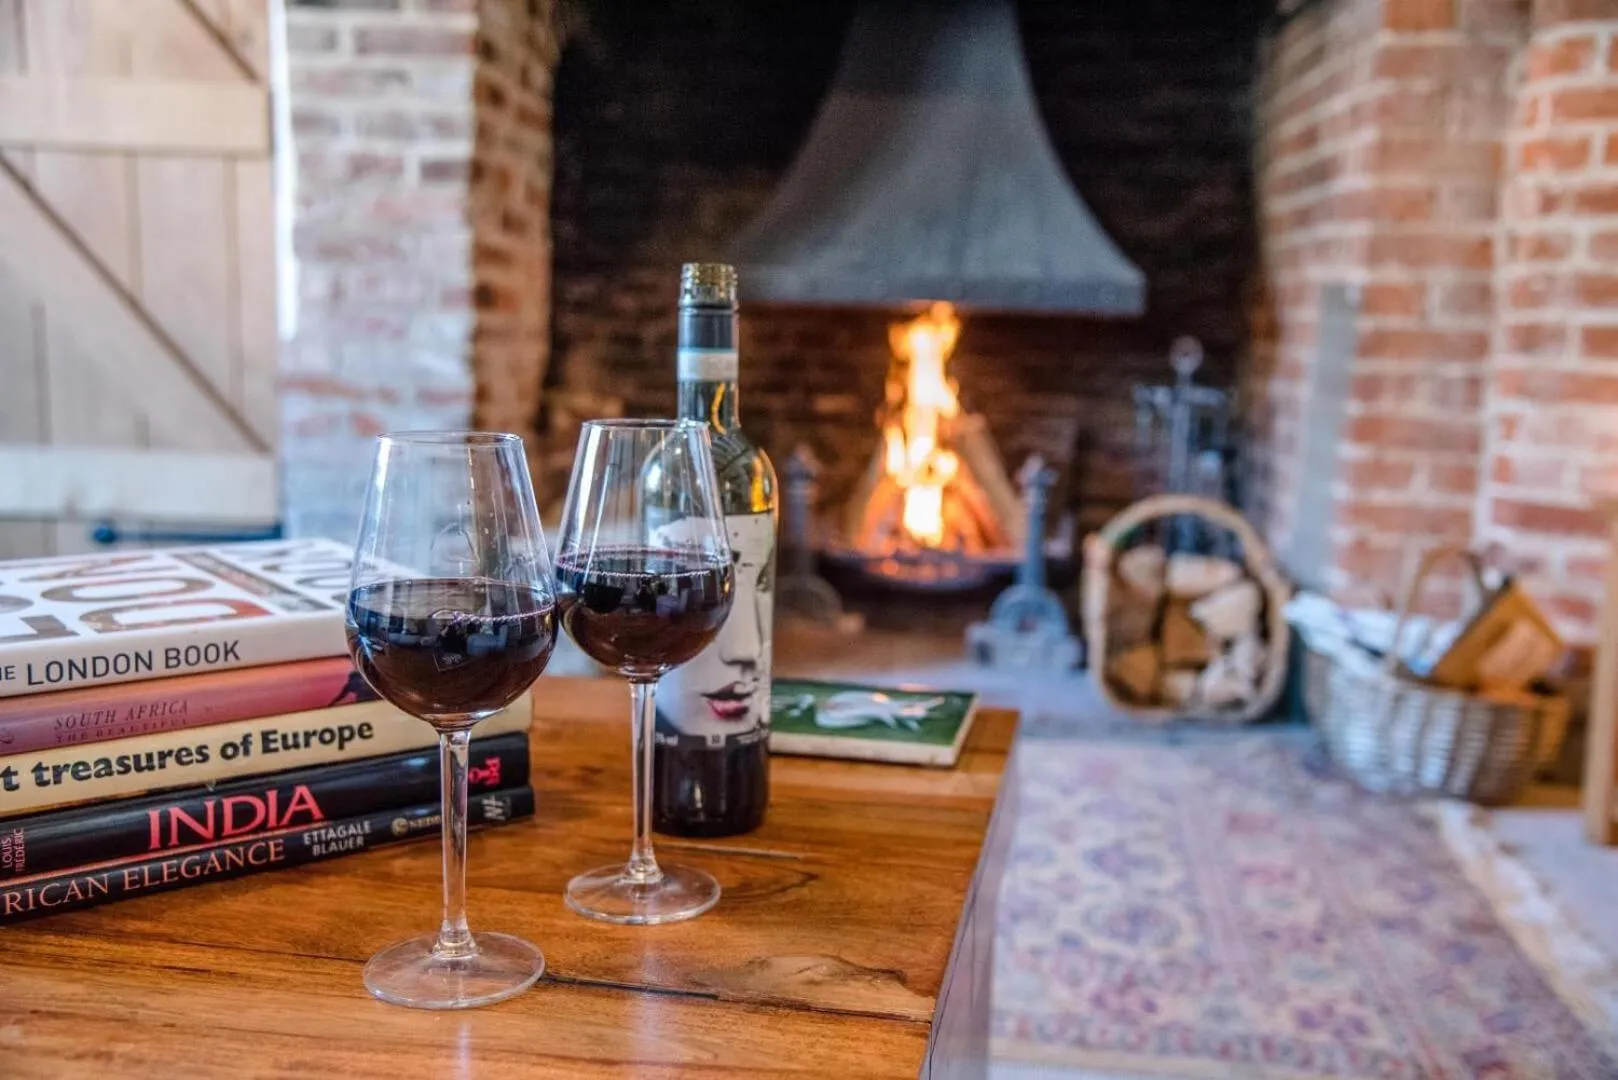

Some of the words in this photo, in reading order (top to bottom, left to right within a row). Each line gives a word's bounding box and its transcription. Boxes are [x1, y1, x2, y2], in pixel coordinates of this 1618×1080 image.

[27, 649, 154, 686] LONDON
[165, 639, 241, 670] BOOK
[54, 710, 117, 731] SOUTH
[125, 700, 189, 721] AFRICA
[55, 731, 89, 744] THE
[96, 718, 189, 739] BEAUTIFUL
[31, 740, 211, 787] treasures
[220, 733, 253, 762] of
[261, 719, 374, 754] Europe
[148, 783, 325, 852] INDIA
[303, 820, 372, 846] ETTAGALE
[312, 834, 366, 858] BLAUER
[2, 873, 109, 916] RICAN
[123, 839, 285, 891] ELEGANCE
